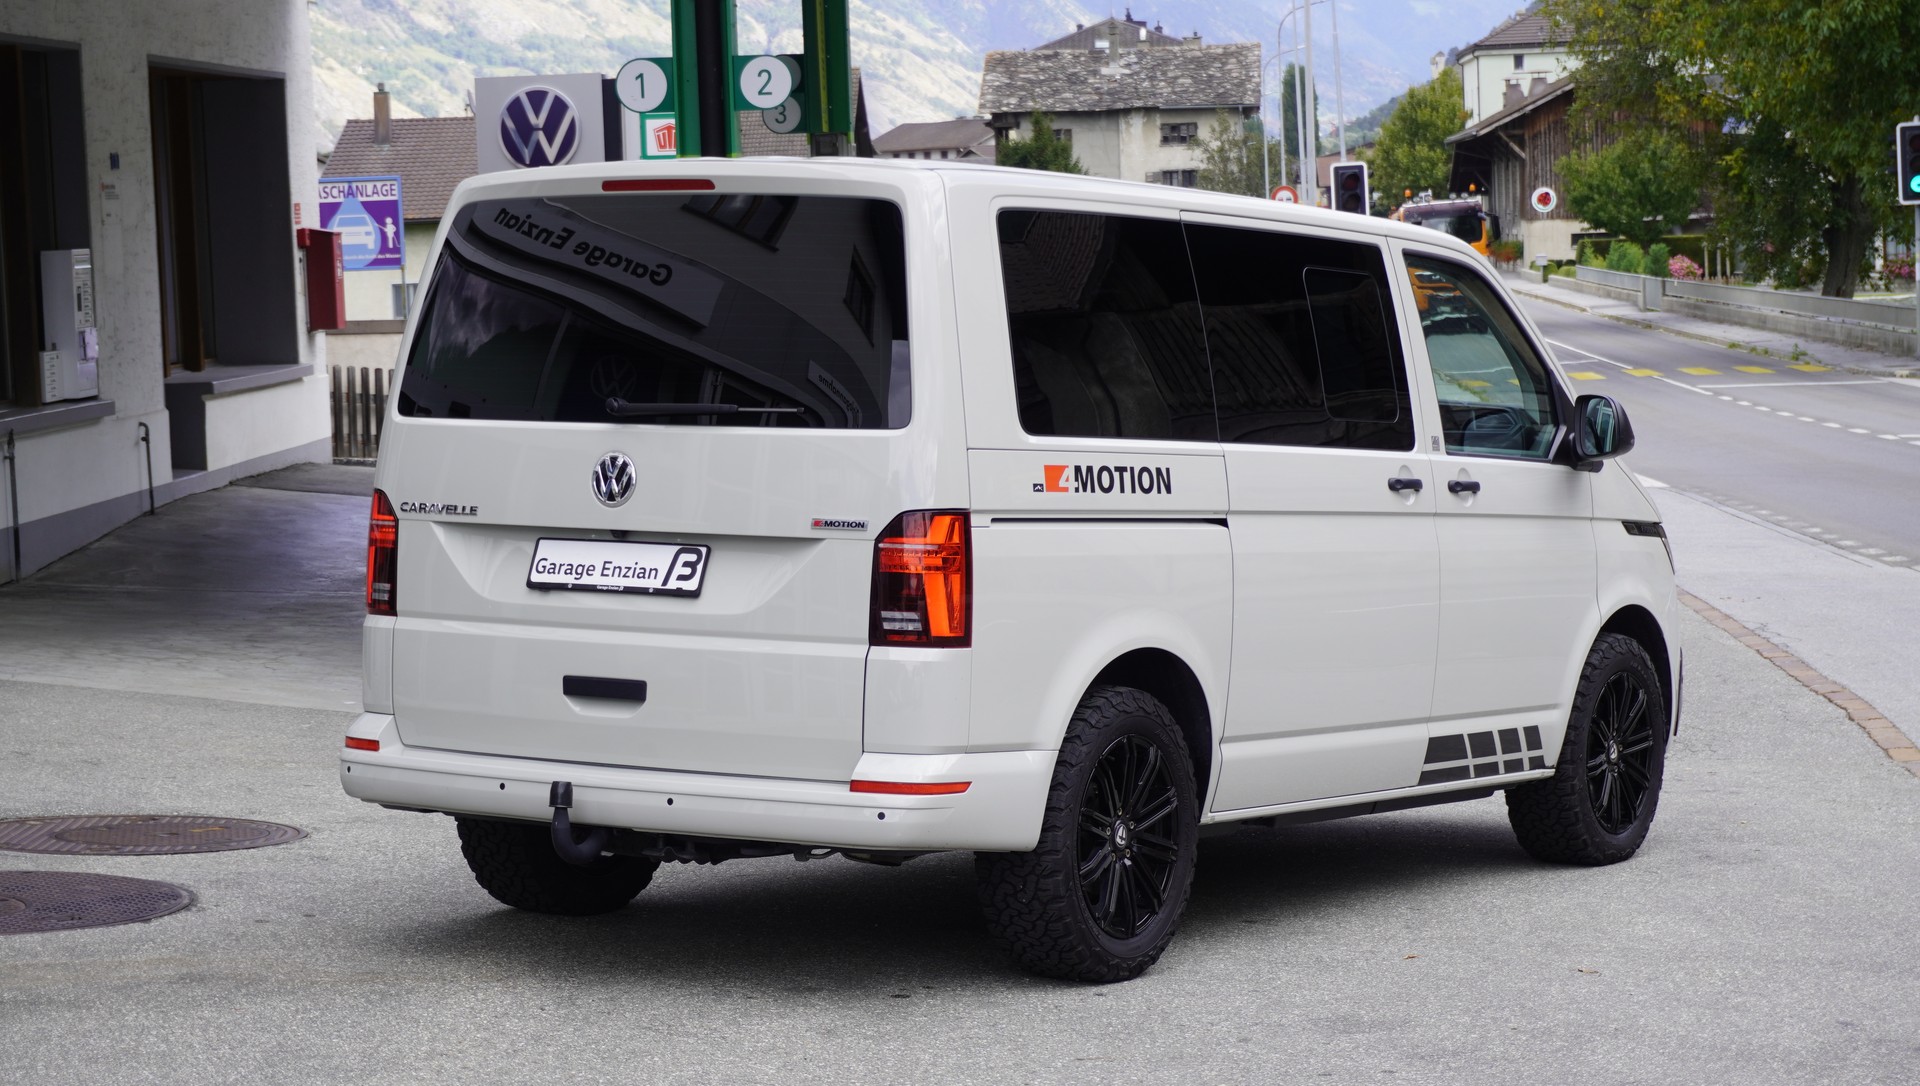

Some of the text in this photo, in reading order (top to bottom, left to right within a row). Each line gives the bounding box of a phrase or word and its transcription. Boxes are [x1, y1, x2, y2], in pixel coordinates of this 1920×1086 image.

[634, 72, 646, 100] 1
[757, 69, 773, 96] 2
[774, 103, 788, 125] 3
[655, 124, 677, 151] UT
[1058, 465, 1172, 494] 4MOTION
[400, 501, 479, 516] CARAVELLE
[535, 557, 596, 581] Garage
[600, 560, 659, 580] Enzian
